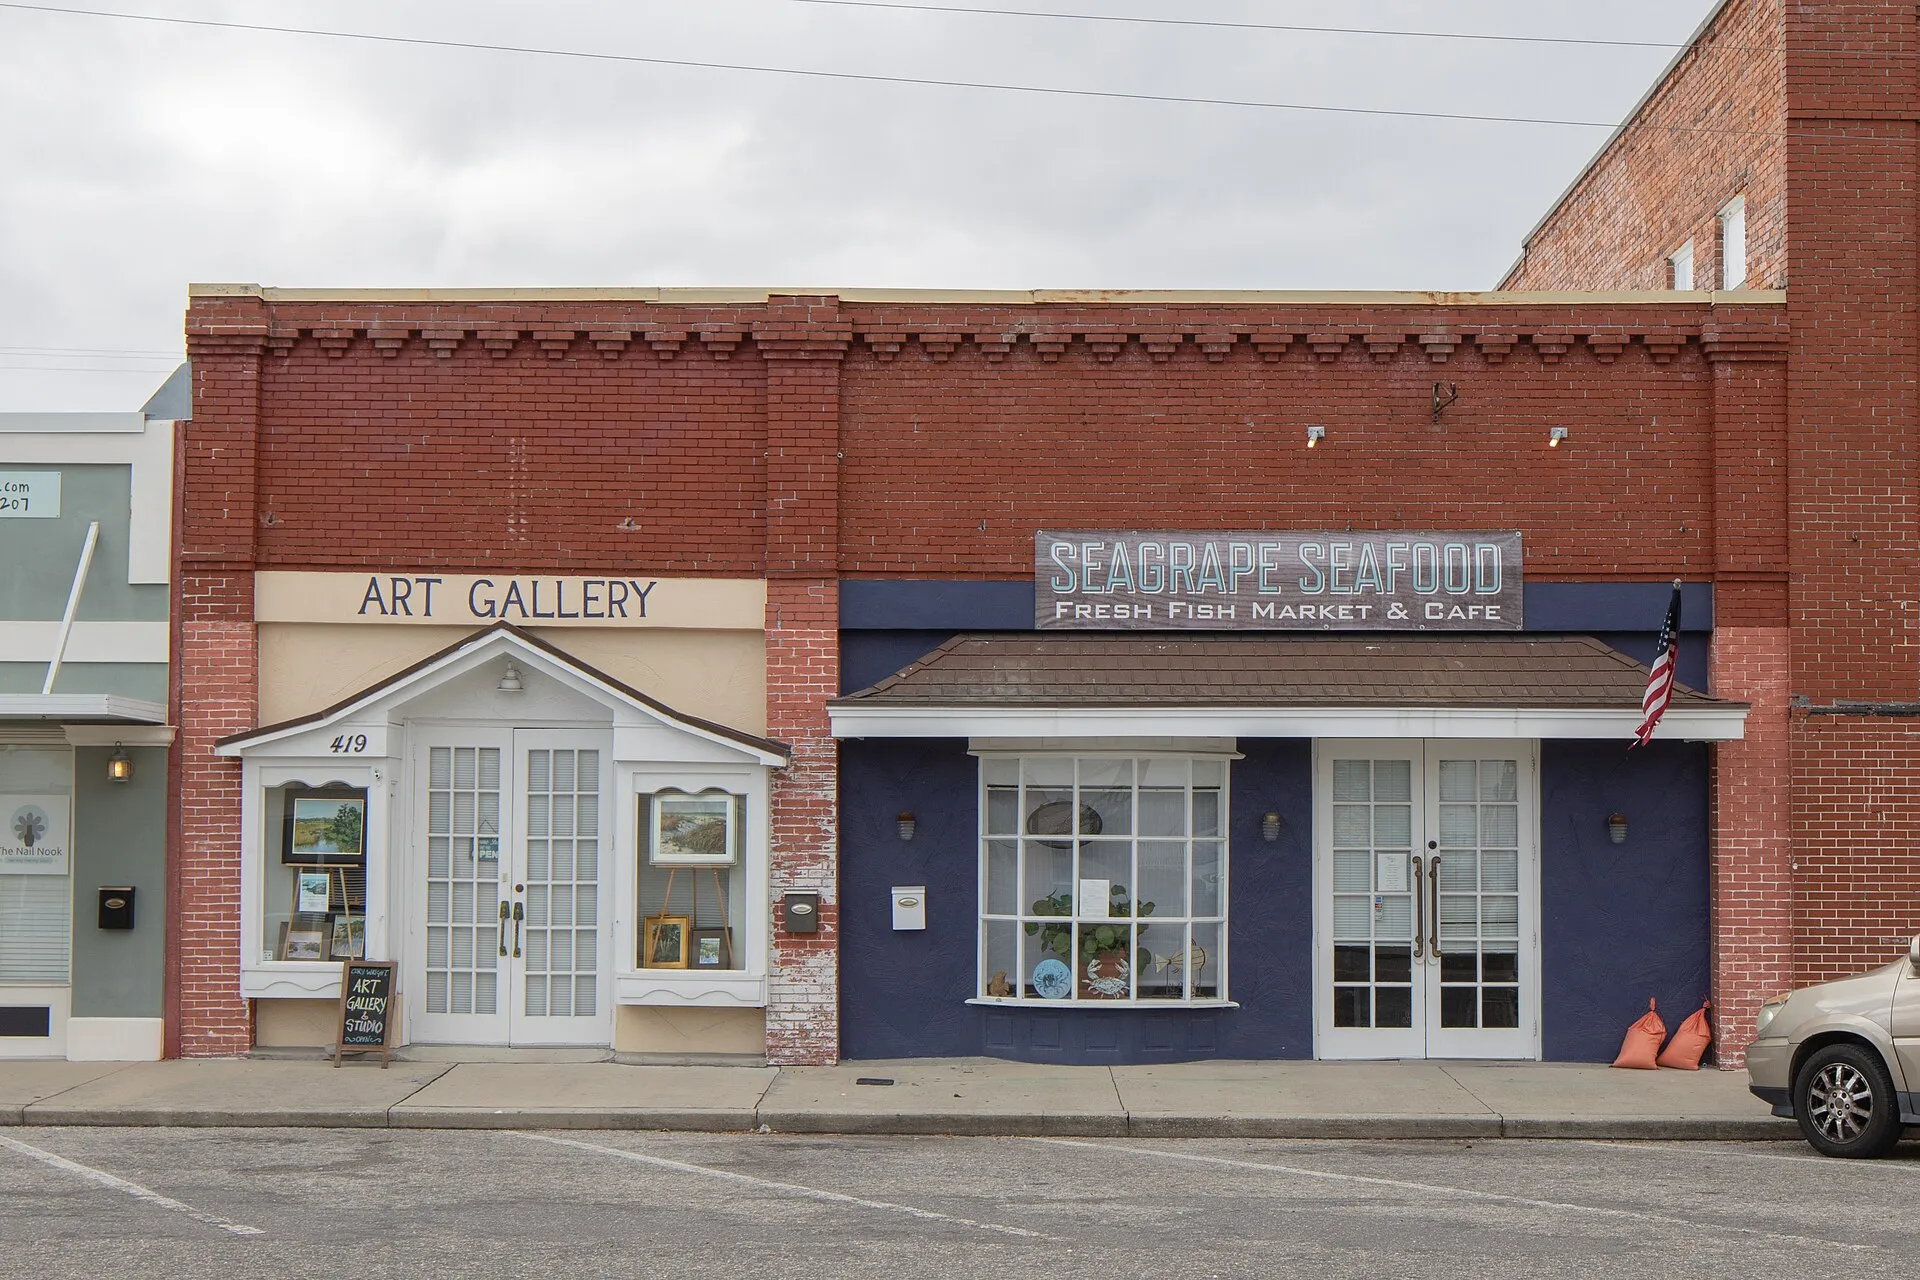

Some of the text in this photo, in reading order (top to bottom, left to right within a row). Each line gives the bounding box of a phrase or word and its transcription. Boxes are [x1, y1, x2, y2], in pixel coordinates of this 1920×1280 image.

[1050, 541, 1503, 595] SEAGRAPE SEAFOOD
[357, 576, 657, 618] ART GALLERY
[1386, 601, 1410, 620] &
[330, 734, 368, 753] 419
[16, 847, 35, 856] Nail
[37, 846, 63, 856] Nook
[472, 850, 499, 859] PEN
[352, 978, 382, 994] ART
[346, 995, 388, 1015] GALLERY
[360, 1010, 369, 1020] &
[345, 1018, 383, 1034] STUDIO
